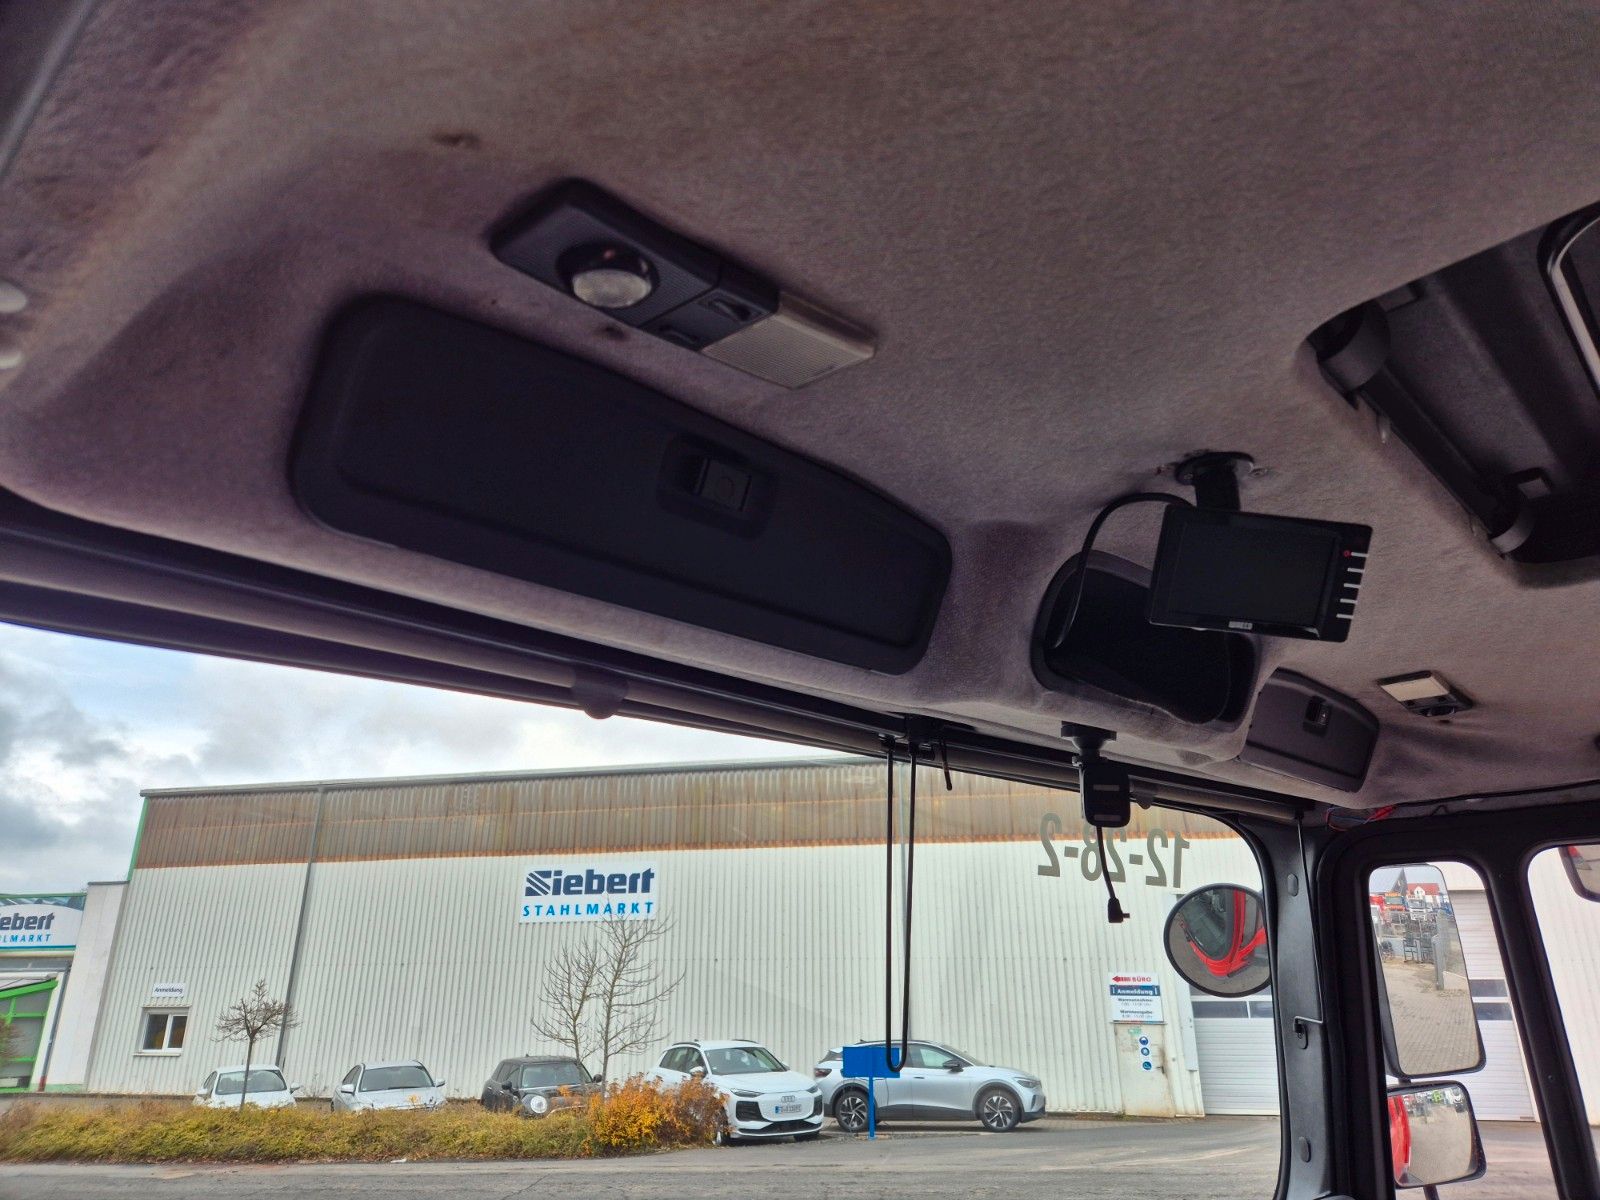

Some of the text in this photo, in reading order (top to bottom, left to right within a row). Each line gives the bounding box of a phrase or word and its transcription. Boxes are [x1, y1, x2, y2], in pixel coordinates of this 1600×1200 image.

[524, 868, 655, 897] Siebert
[523, 902, 653, 917] STAHLMARKT
[0, 912, 55, 931] ebert
[0, 934, 52, 943] LMARKT
[1117, 988, 1154, 996] Anmeldung
